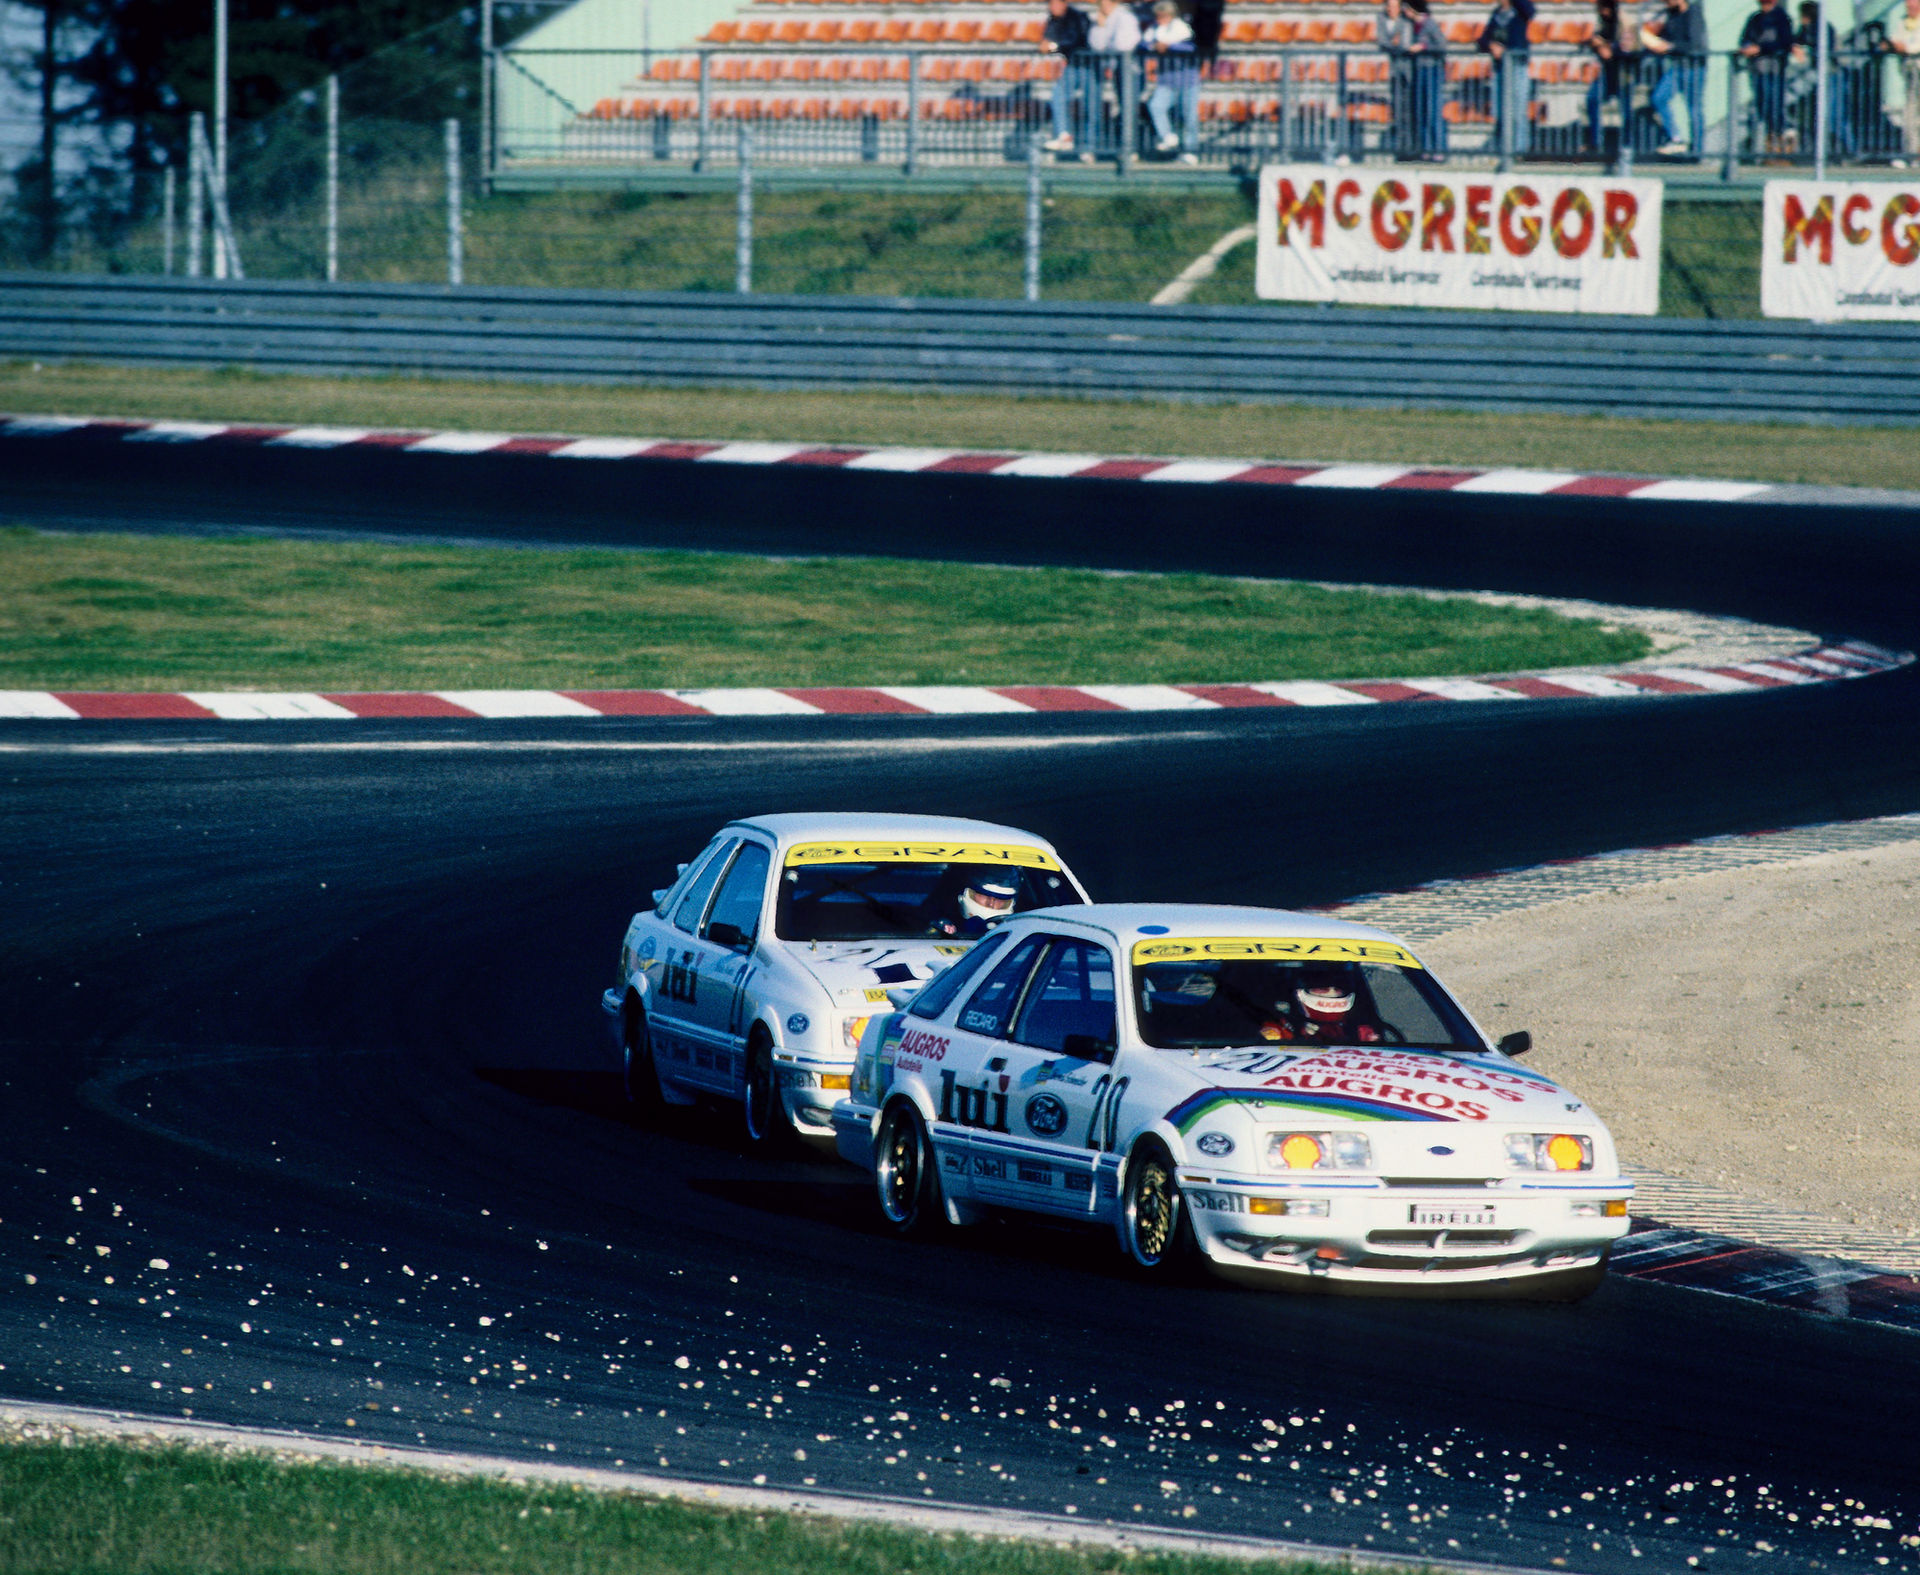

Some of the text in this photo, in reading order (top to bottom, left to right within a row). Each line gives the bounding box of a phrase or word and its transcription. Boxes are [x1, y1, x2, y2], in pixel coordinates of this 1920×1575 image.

[898, 1029, 951, 1062] AUGROS
[1296, 1057, 1526, 1103] AUGROS
[1330, 1048, 1558, 1094] AUGROS
[937, 1069, 1012, 1136] lui
[1085, 1072, 1130, 1153] 20
[1260, 1074, 1490, 1121] AUGROS
[1192, 1191, 1246, 1214] Shell
